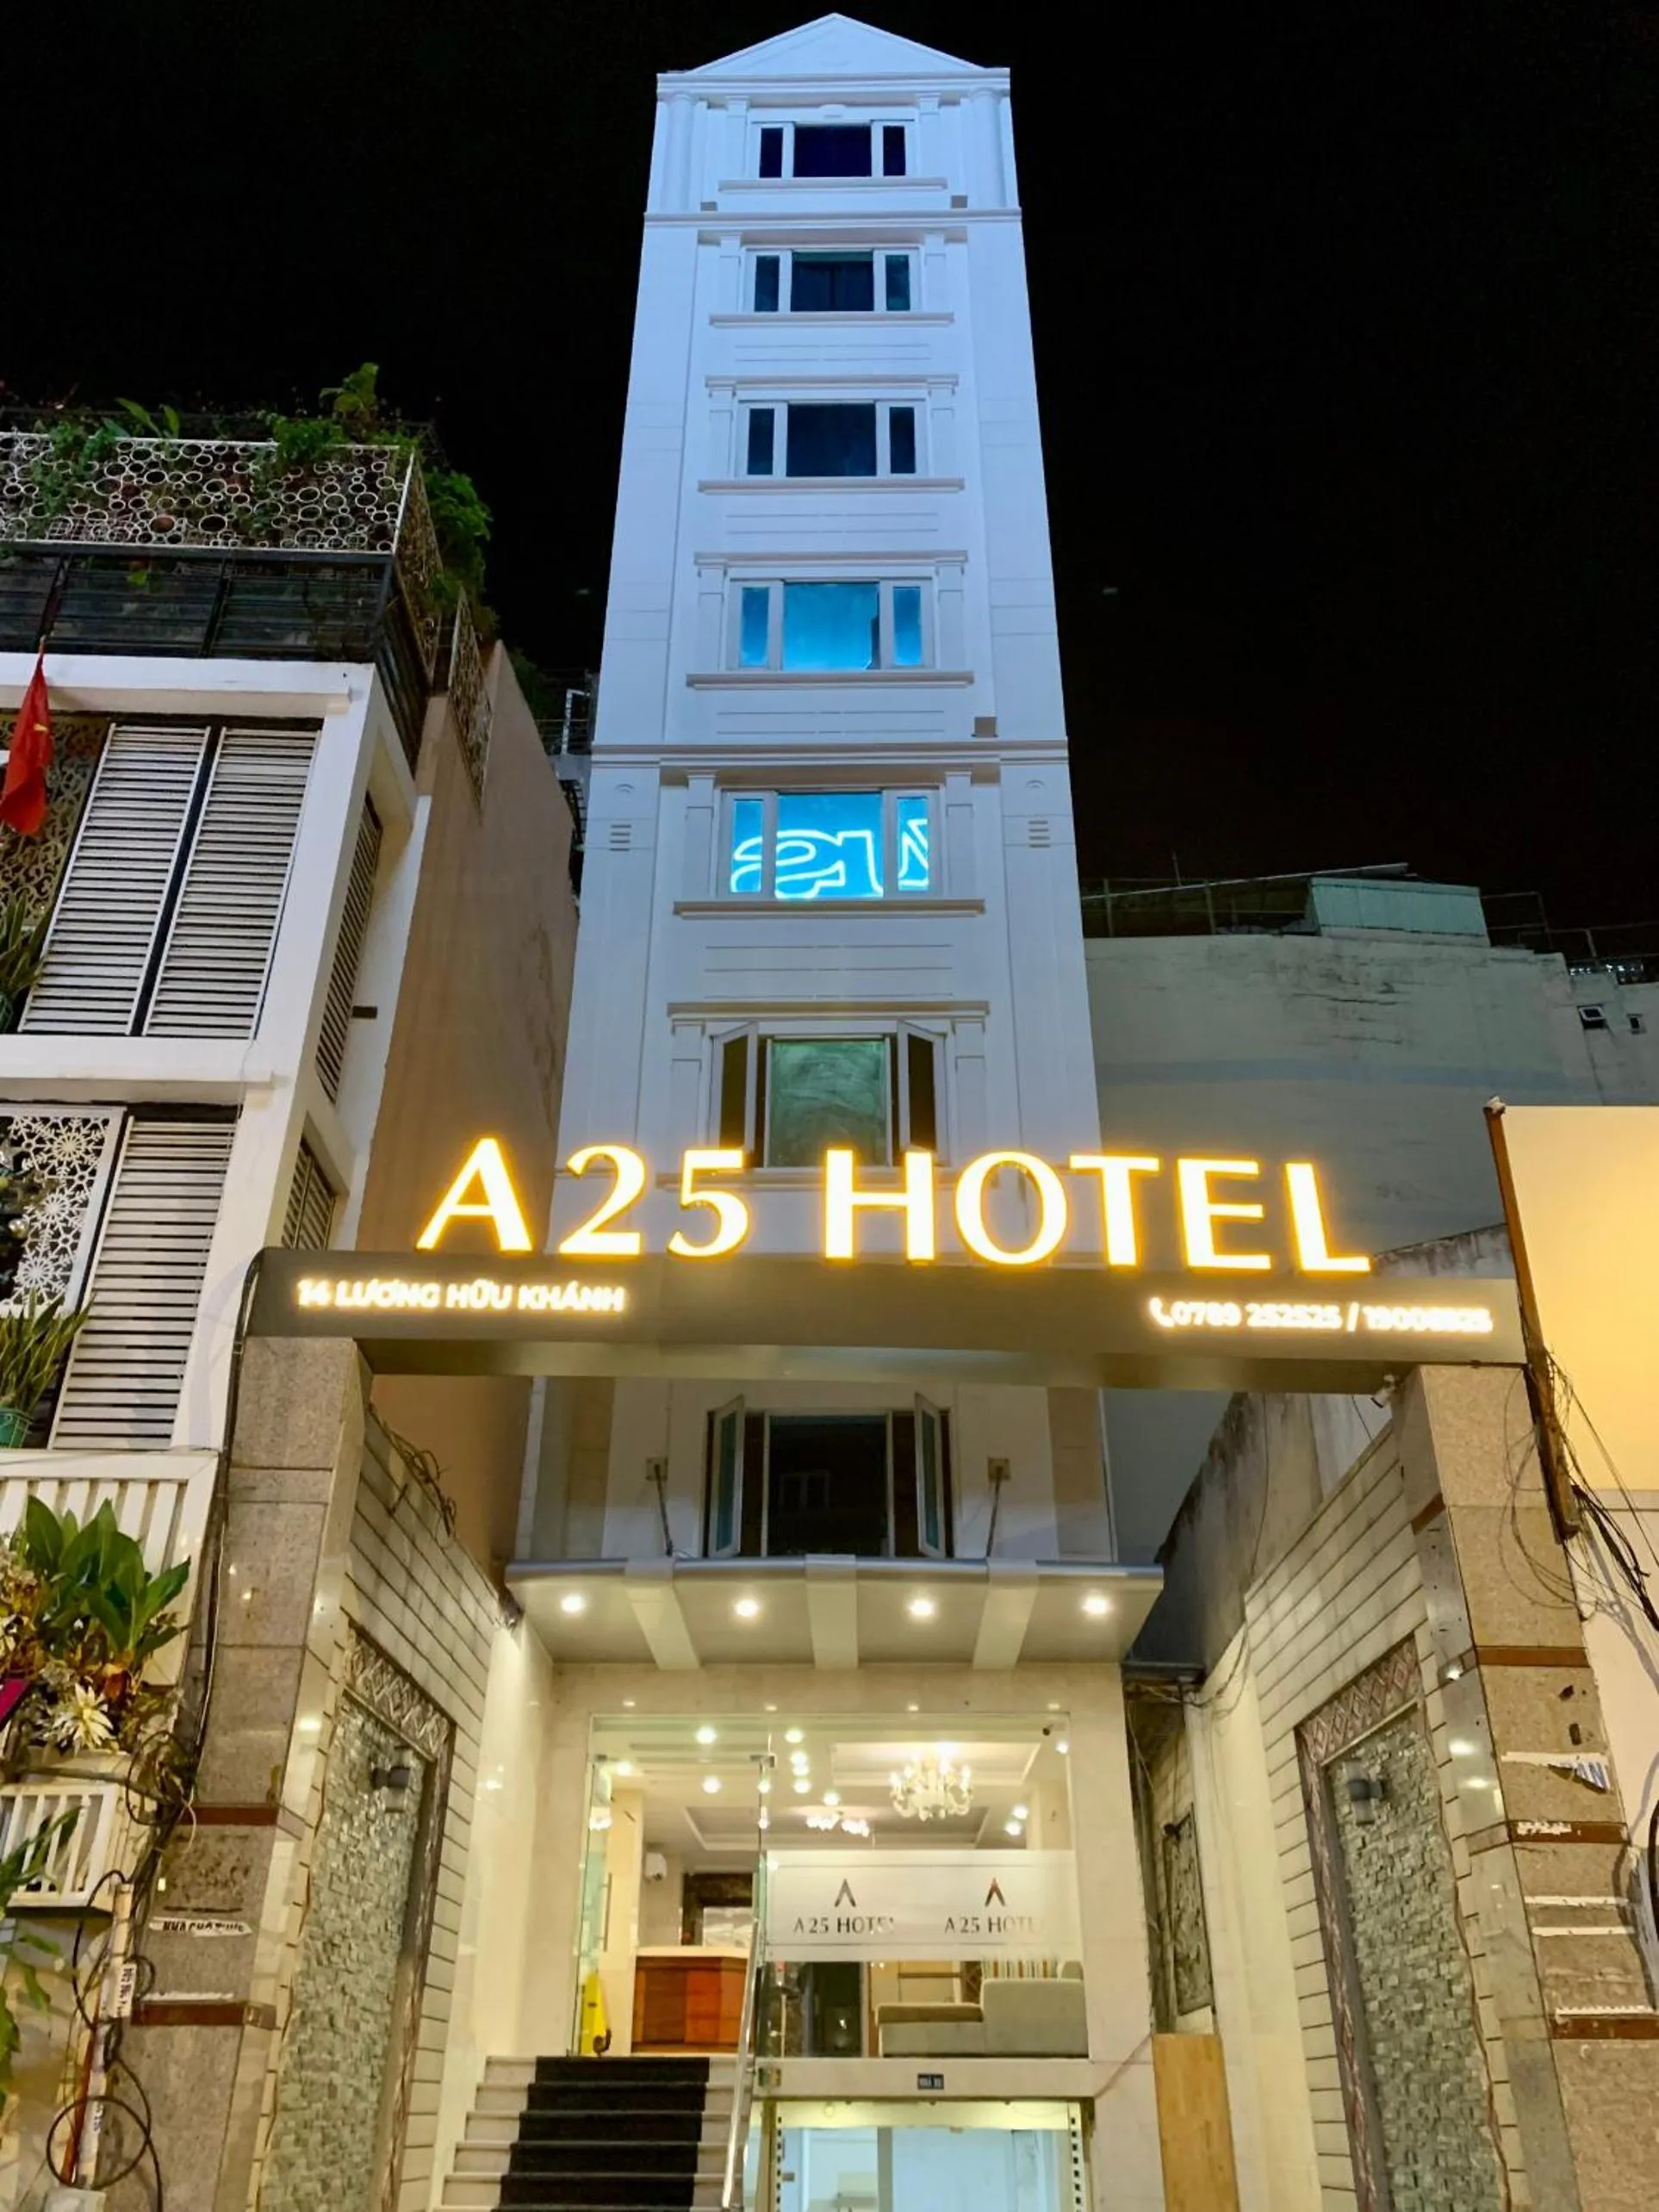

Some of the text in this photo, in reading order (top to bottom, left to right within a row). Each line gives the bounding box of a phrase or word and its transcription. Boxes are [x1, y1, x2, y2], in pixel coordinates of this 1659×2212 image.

[415, 1137, 1370, 1272] A25 HOTEL
[987, 1915, 1044, 1935] HOT
